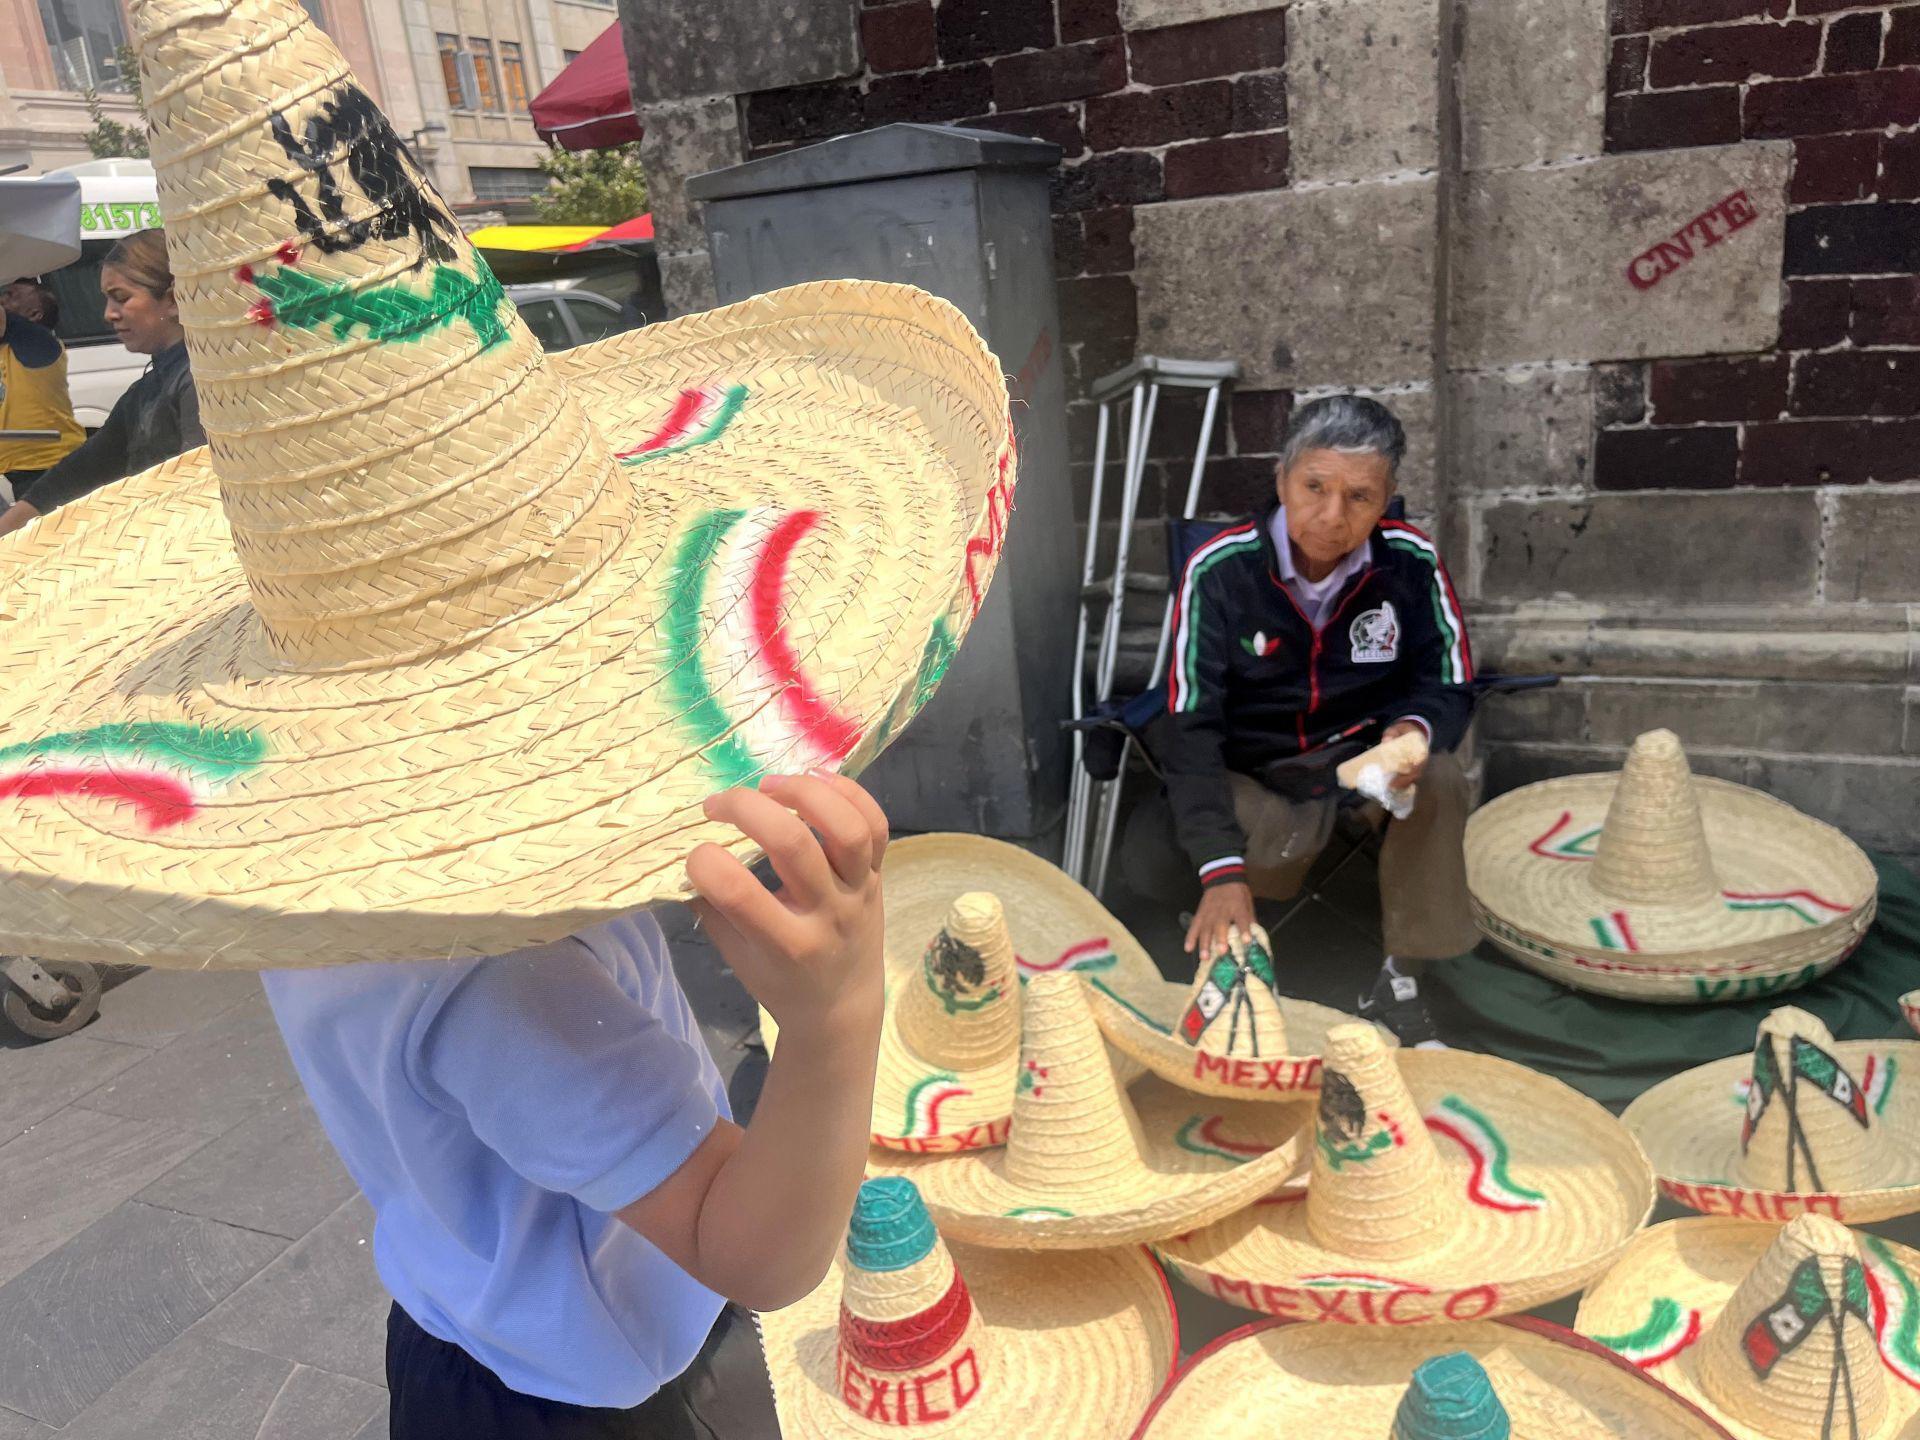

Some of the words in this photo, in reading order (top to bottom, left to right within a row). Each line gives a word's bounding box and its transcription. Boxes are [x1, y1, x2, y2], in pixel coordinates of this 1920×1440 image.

[1626, 189, 1757, 291] CNTE
[1208, 1272, 1500, 1325] MEXICO
[837, 1346, 980, 1426] EXICO
